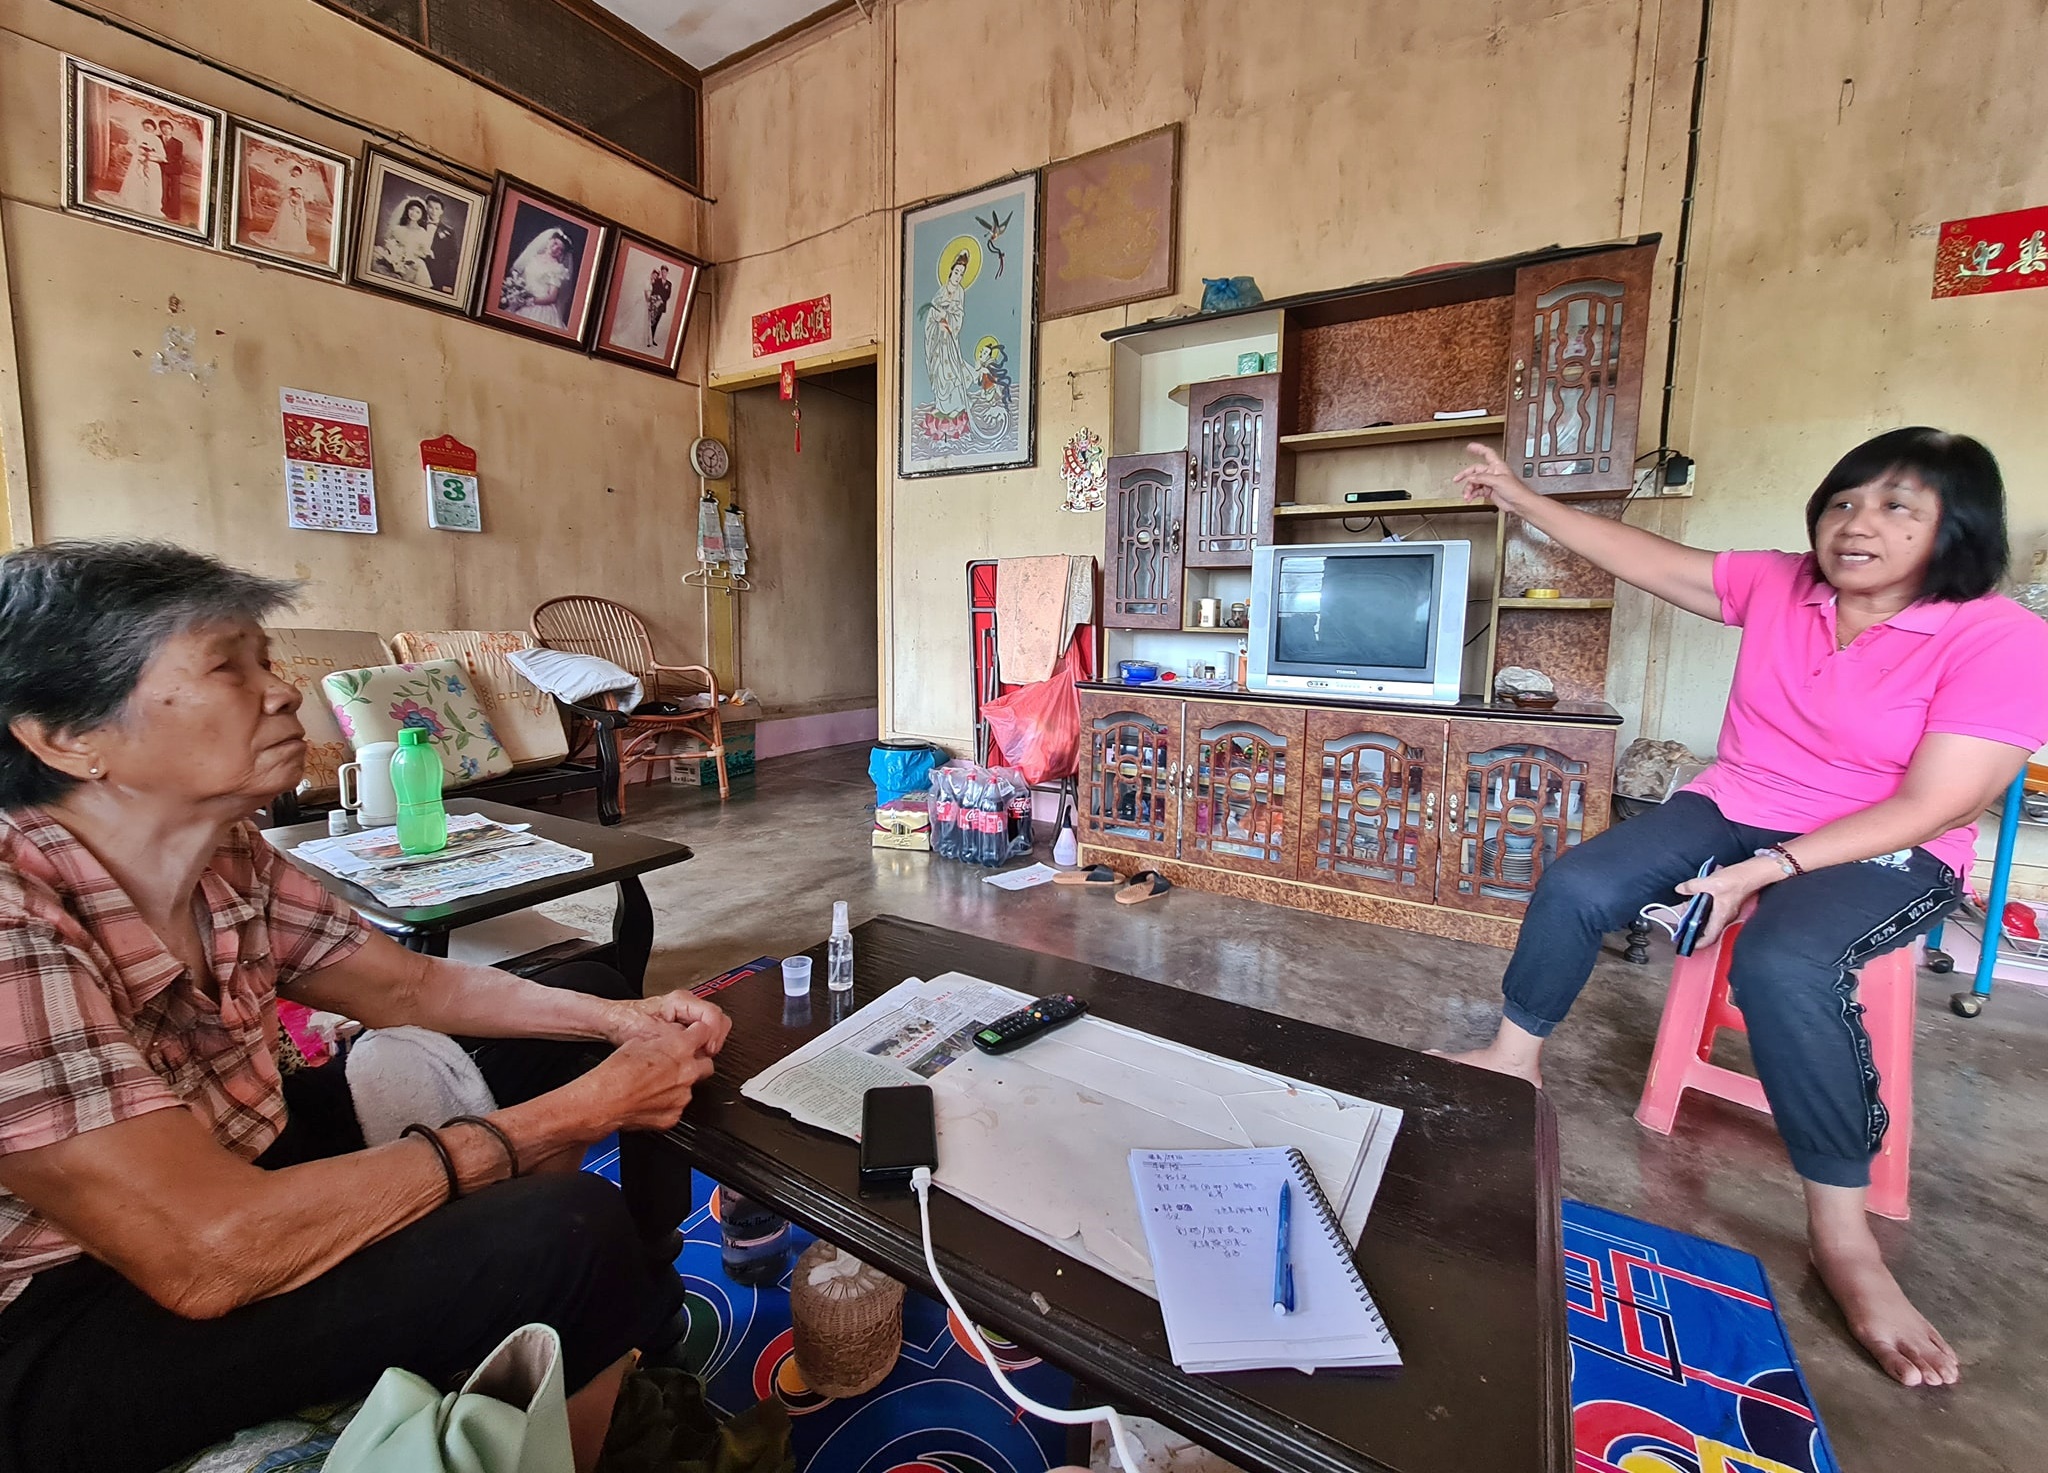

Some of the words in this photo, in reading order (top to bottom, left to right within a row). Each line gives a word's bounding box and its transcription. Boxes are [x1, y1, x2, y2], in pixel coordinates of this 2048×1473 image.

[309, 421, 350, 460] 福
[443, 479, 466, 501] 3
[1908, 898, 1934, 920] VLTN
[1869, 923, 1897, 945] VLTN
